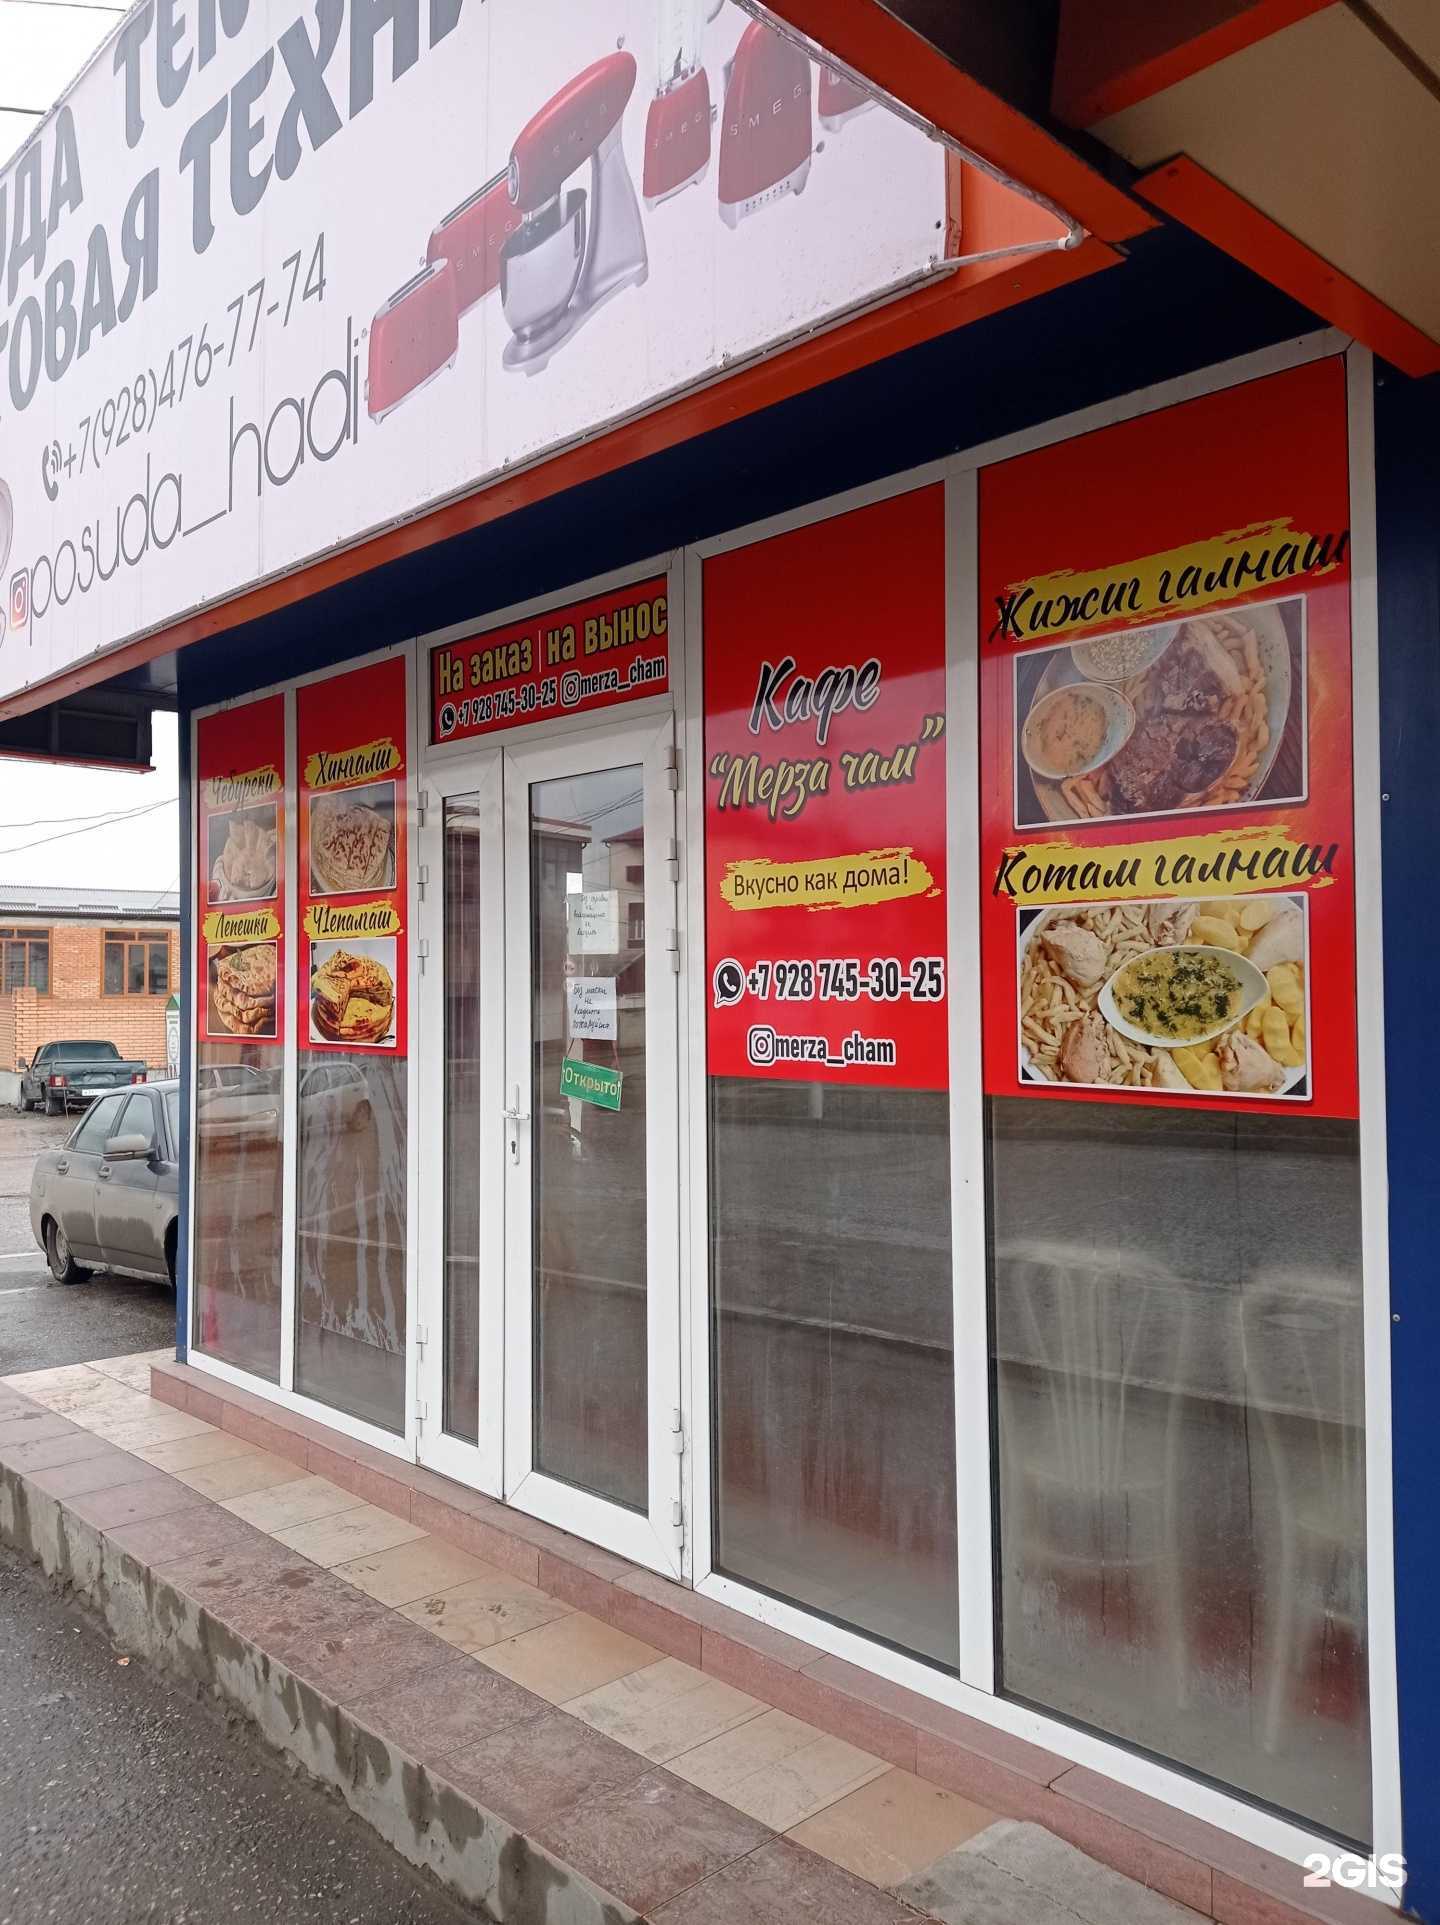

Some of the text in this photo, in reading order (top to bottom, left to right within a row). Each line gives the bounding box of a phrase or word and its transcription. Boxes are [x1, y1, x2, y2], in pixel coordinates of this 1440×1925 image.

[0, 105, 83, 307] ДА
[0, 167, 160, 411] ОВАЯ
[62, 232, 327, 480] +7(928)476-77-74
[439, 651, 464, 695] На
[470, 638, 533, 687] заказ
[458, 679, 557, 727] +7 928 745-30-25
[748, 656, 882, 746] Кафе
[734, 858, 909, 900] Вкусно как дома!
[992, 849, 1142, 897] Котам
[215, 912, 269, 939] Лепешки
[748, 960, 942, 999] +7 928 745-30-25
